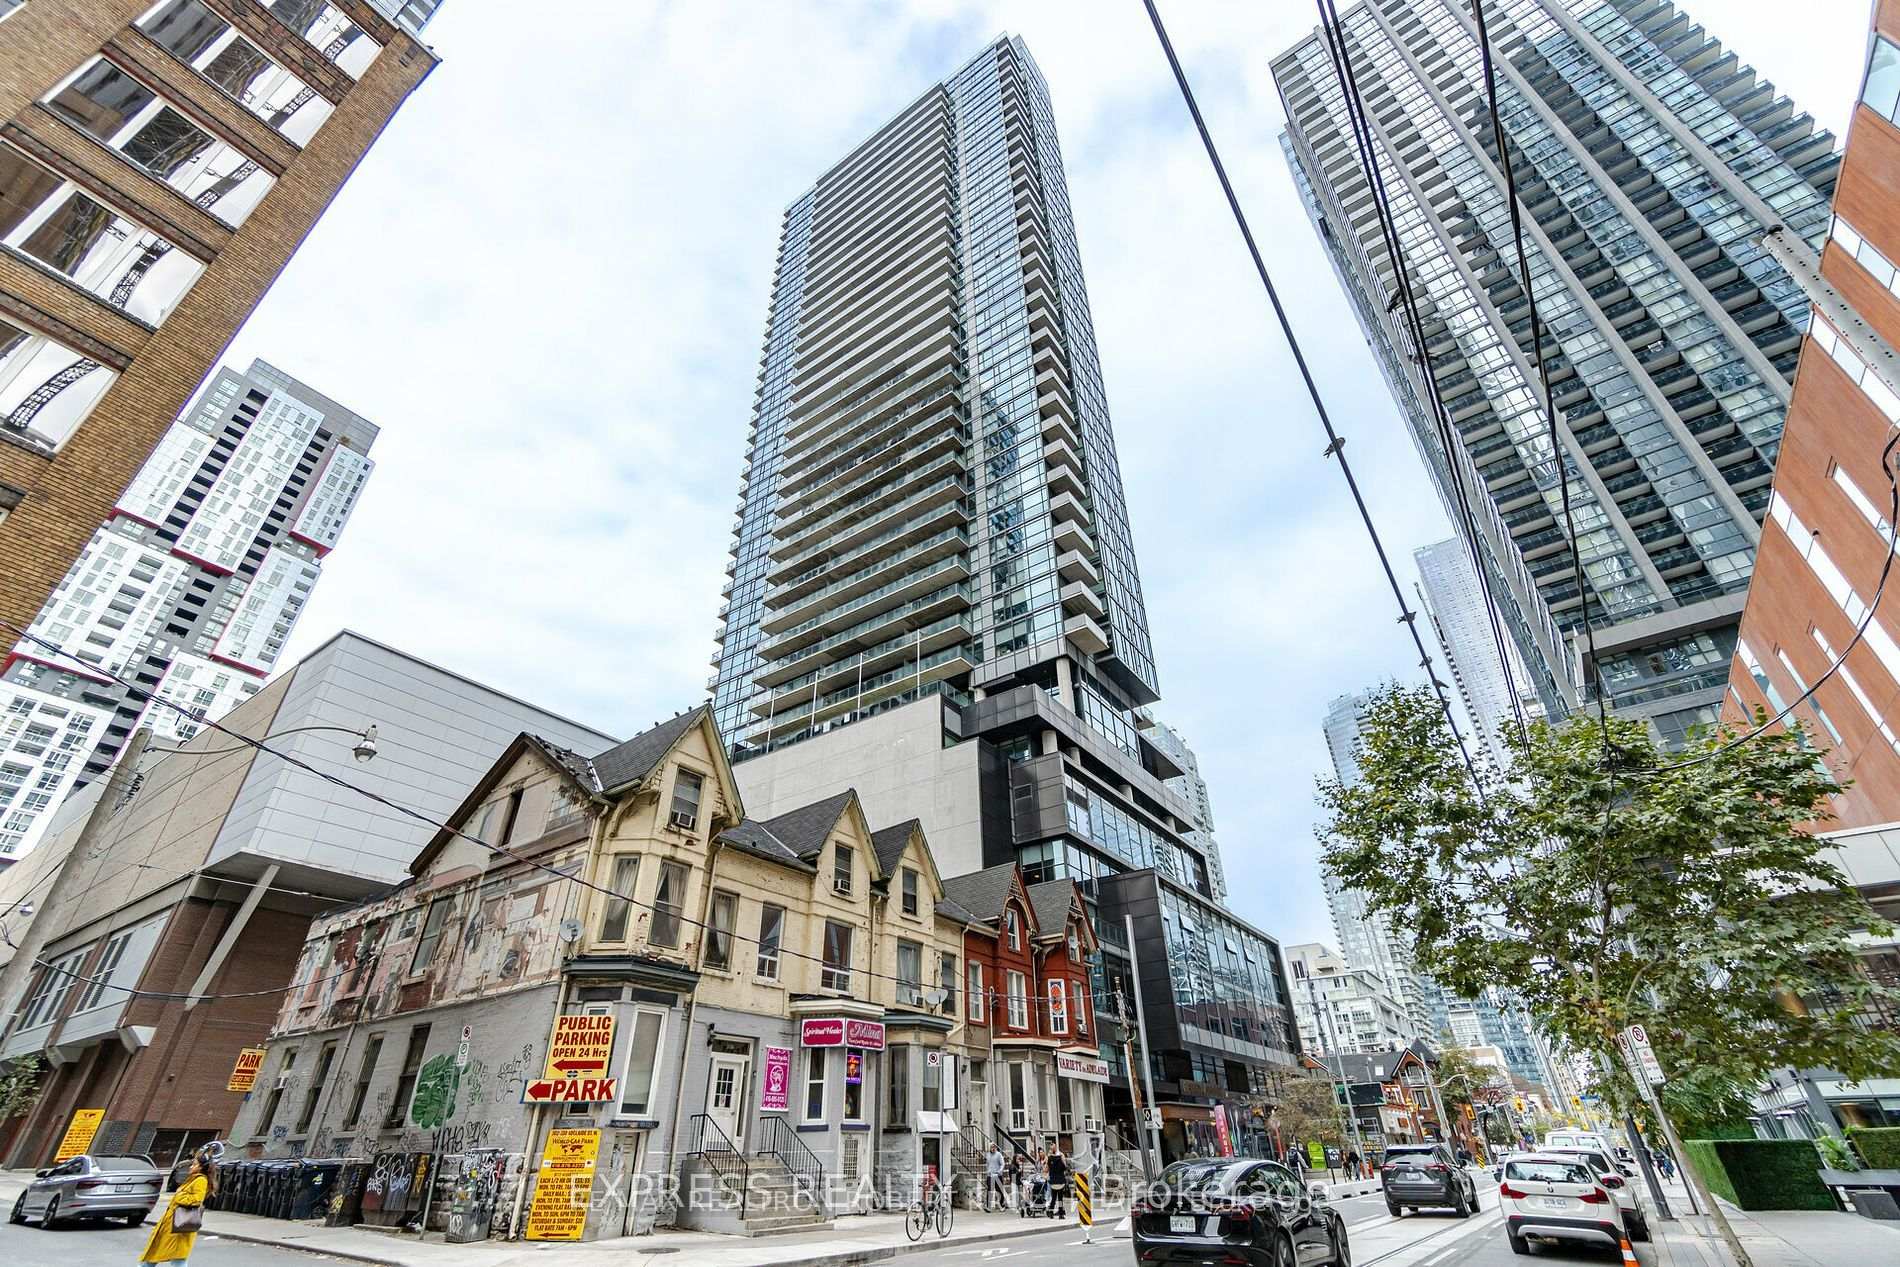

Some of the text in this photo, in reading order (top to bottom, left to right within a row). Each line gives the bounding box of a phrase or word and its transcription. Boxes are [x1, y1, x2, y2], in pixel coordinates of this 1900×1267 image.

[559, 1016, 612, 1031] PUBLIC
[554, 1031, 610, 1046] PARKING
[552, 1047, 608, 1058] OPEN 24 Hrs
[238, 1054, 263, 1069] PARK
[1058, 1057, 1082, 1072] VARIETY
[550, 1079, 617, 1102] PARK
